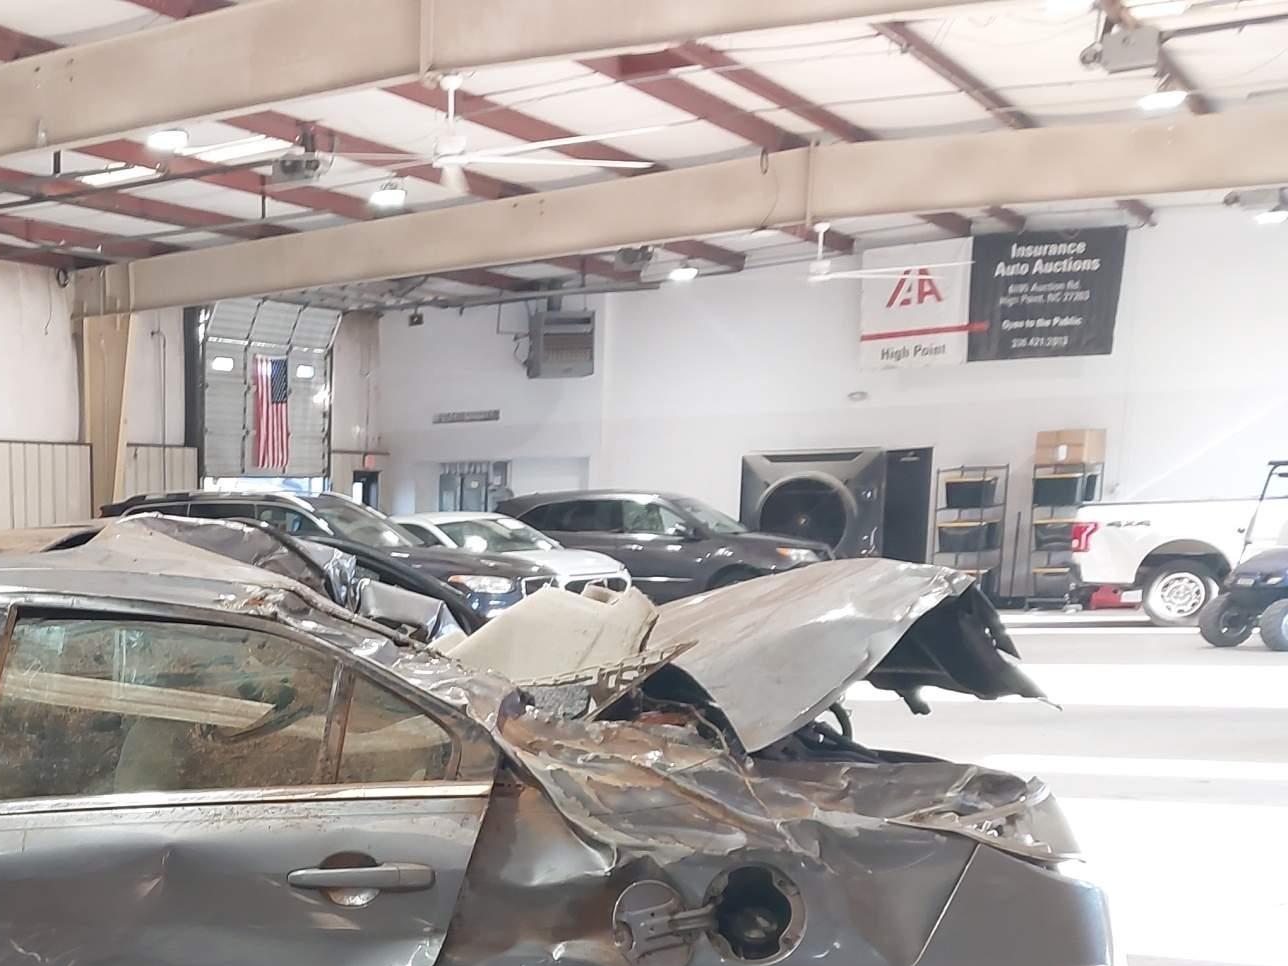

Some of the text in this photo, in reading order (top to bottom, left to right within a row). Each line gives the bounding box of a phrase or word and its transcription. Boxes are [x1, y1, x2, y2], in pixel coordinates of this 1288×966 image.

[1011, 241, 1088, 259] Insurance
[994, 257, 1102, 278] Auto Auctions
[881, 343, 947, 361] High Point
